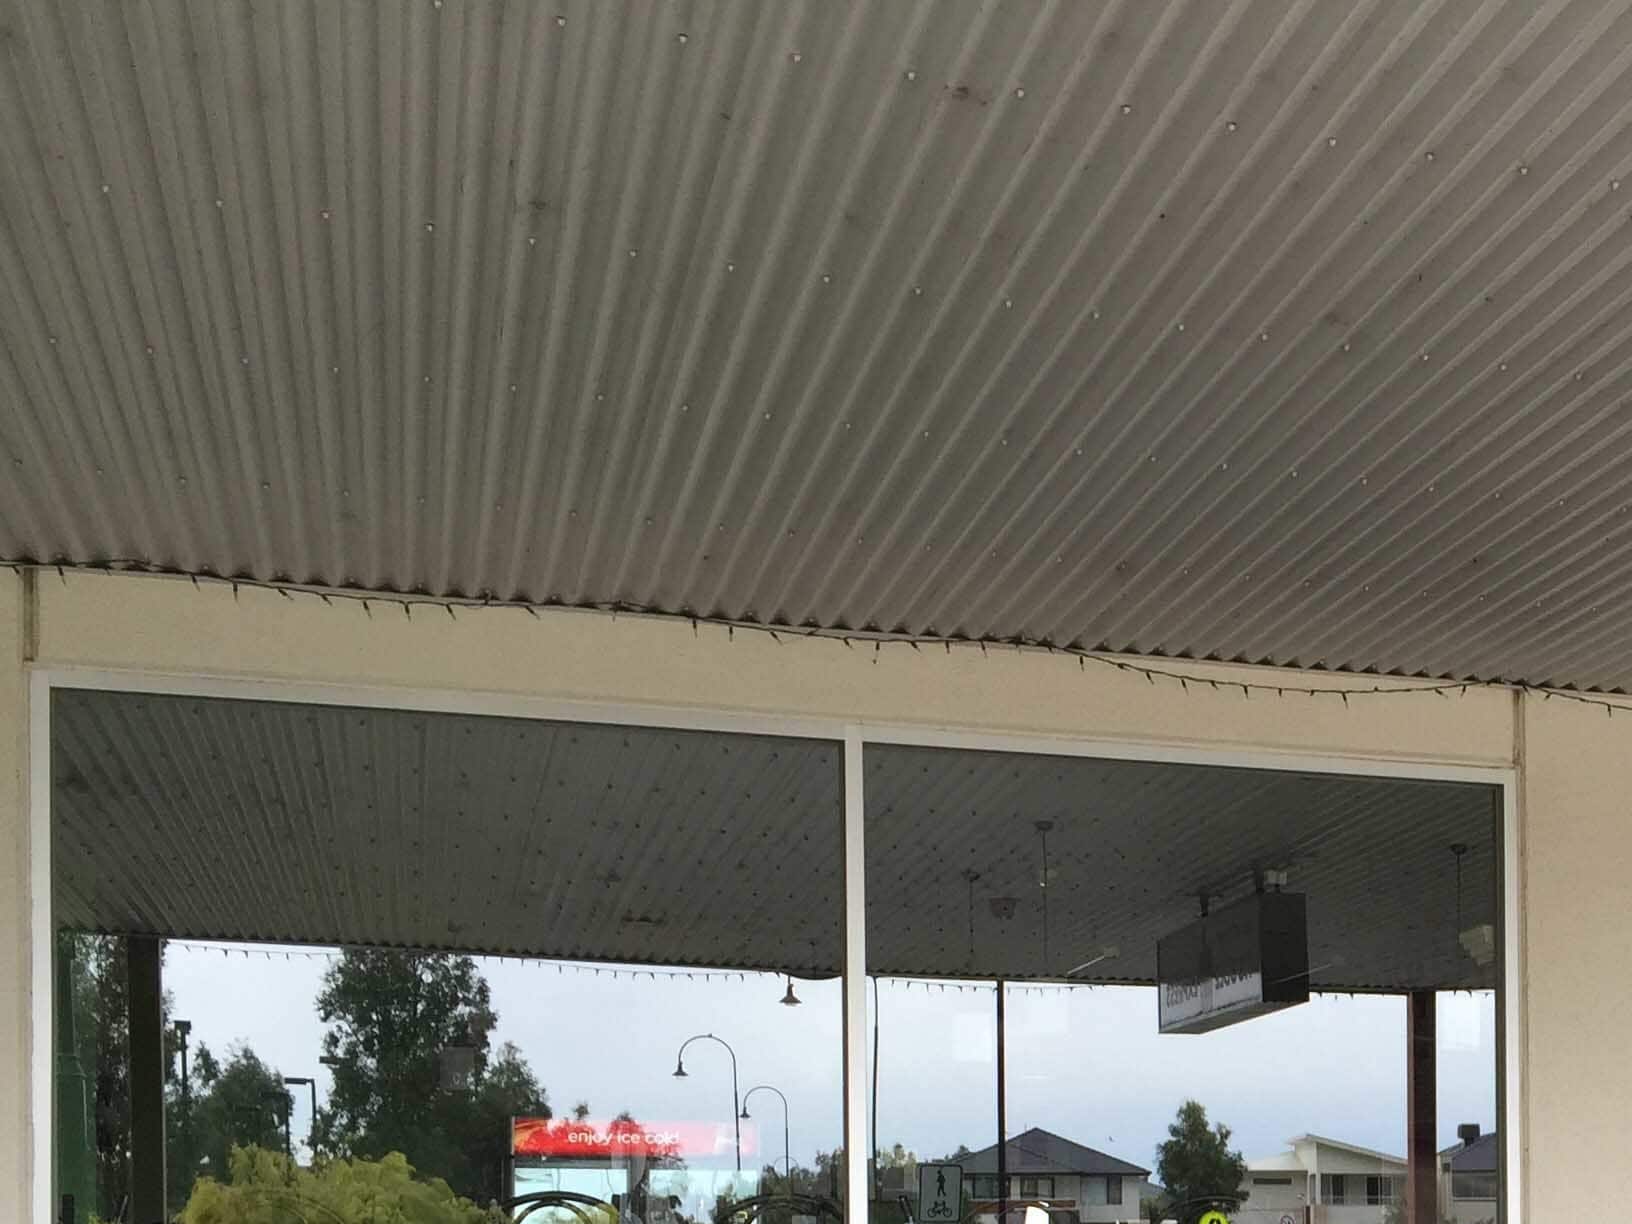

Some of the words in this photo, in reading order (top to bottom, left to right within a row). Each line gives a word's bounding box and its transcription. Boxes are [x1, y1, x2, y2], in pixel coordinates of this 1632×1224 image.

[567, 1131, 613, 1147] enjoy
[617, 1130, 641, 1144] ice
[645, 1130, 680, 1145] cold
